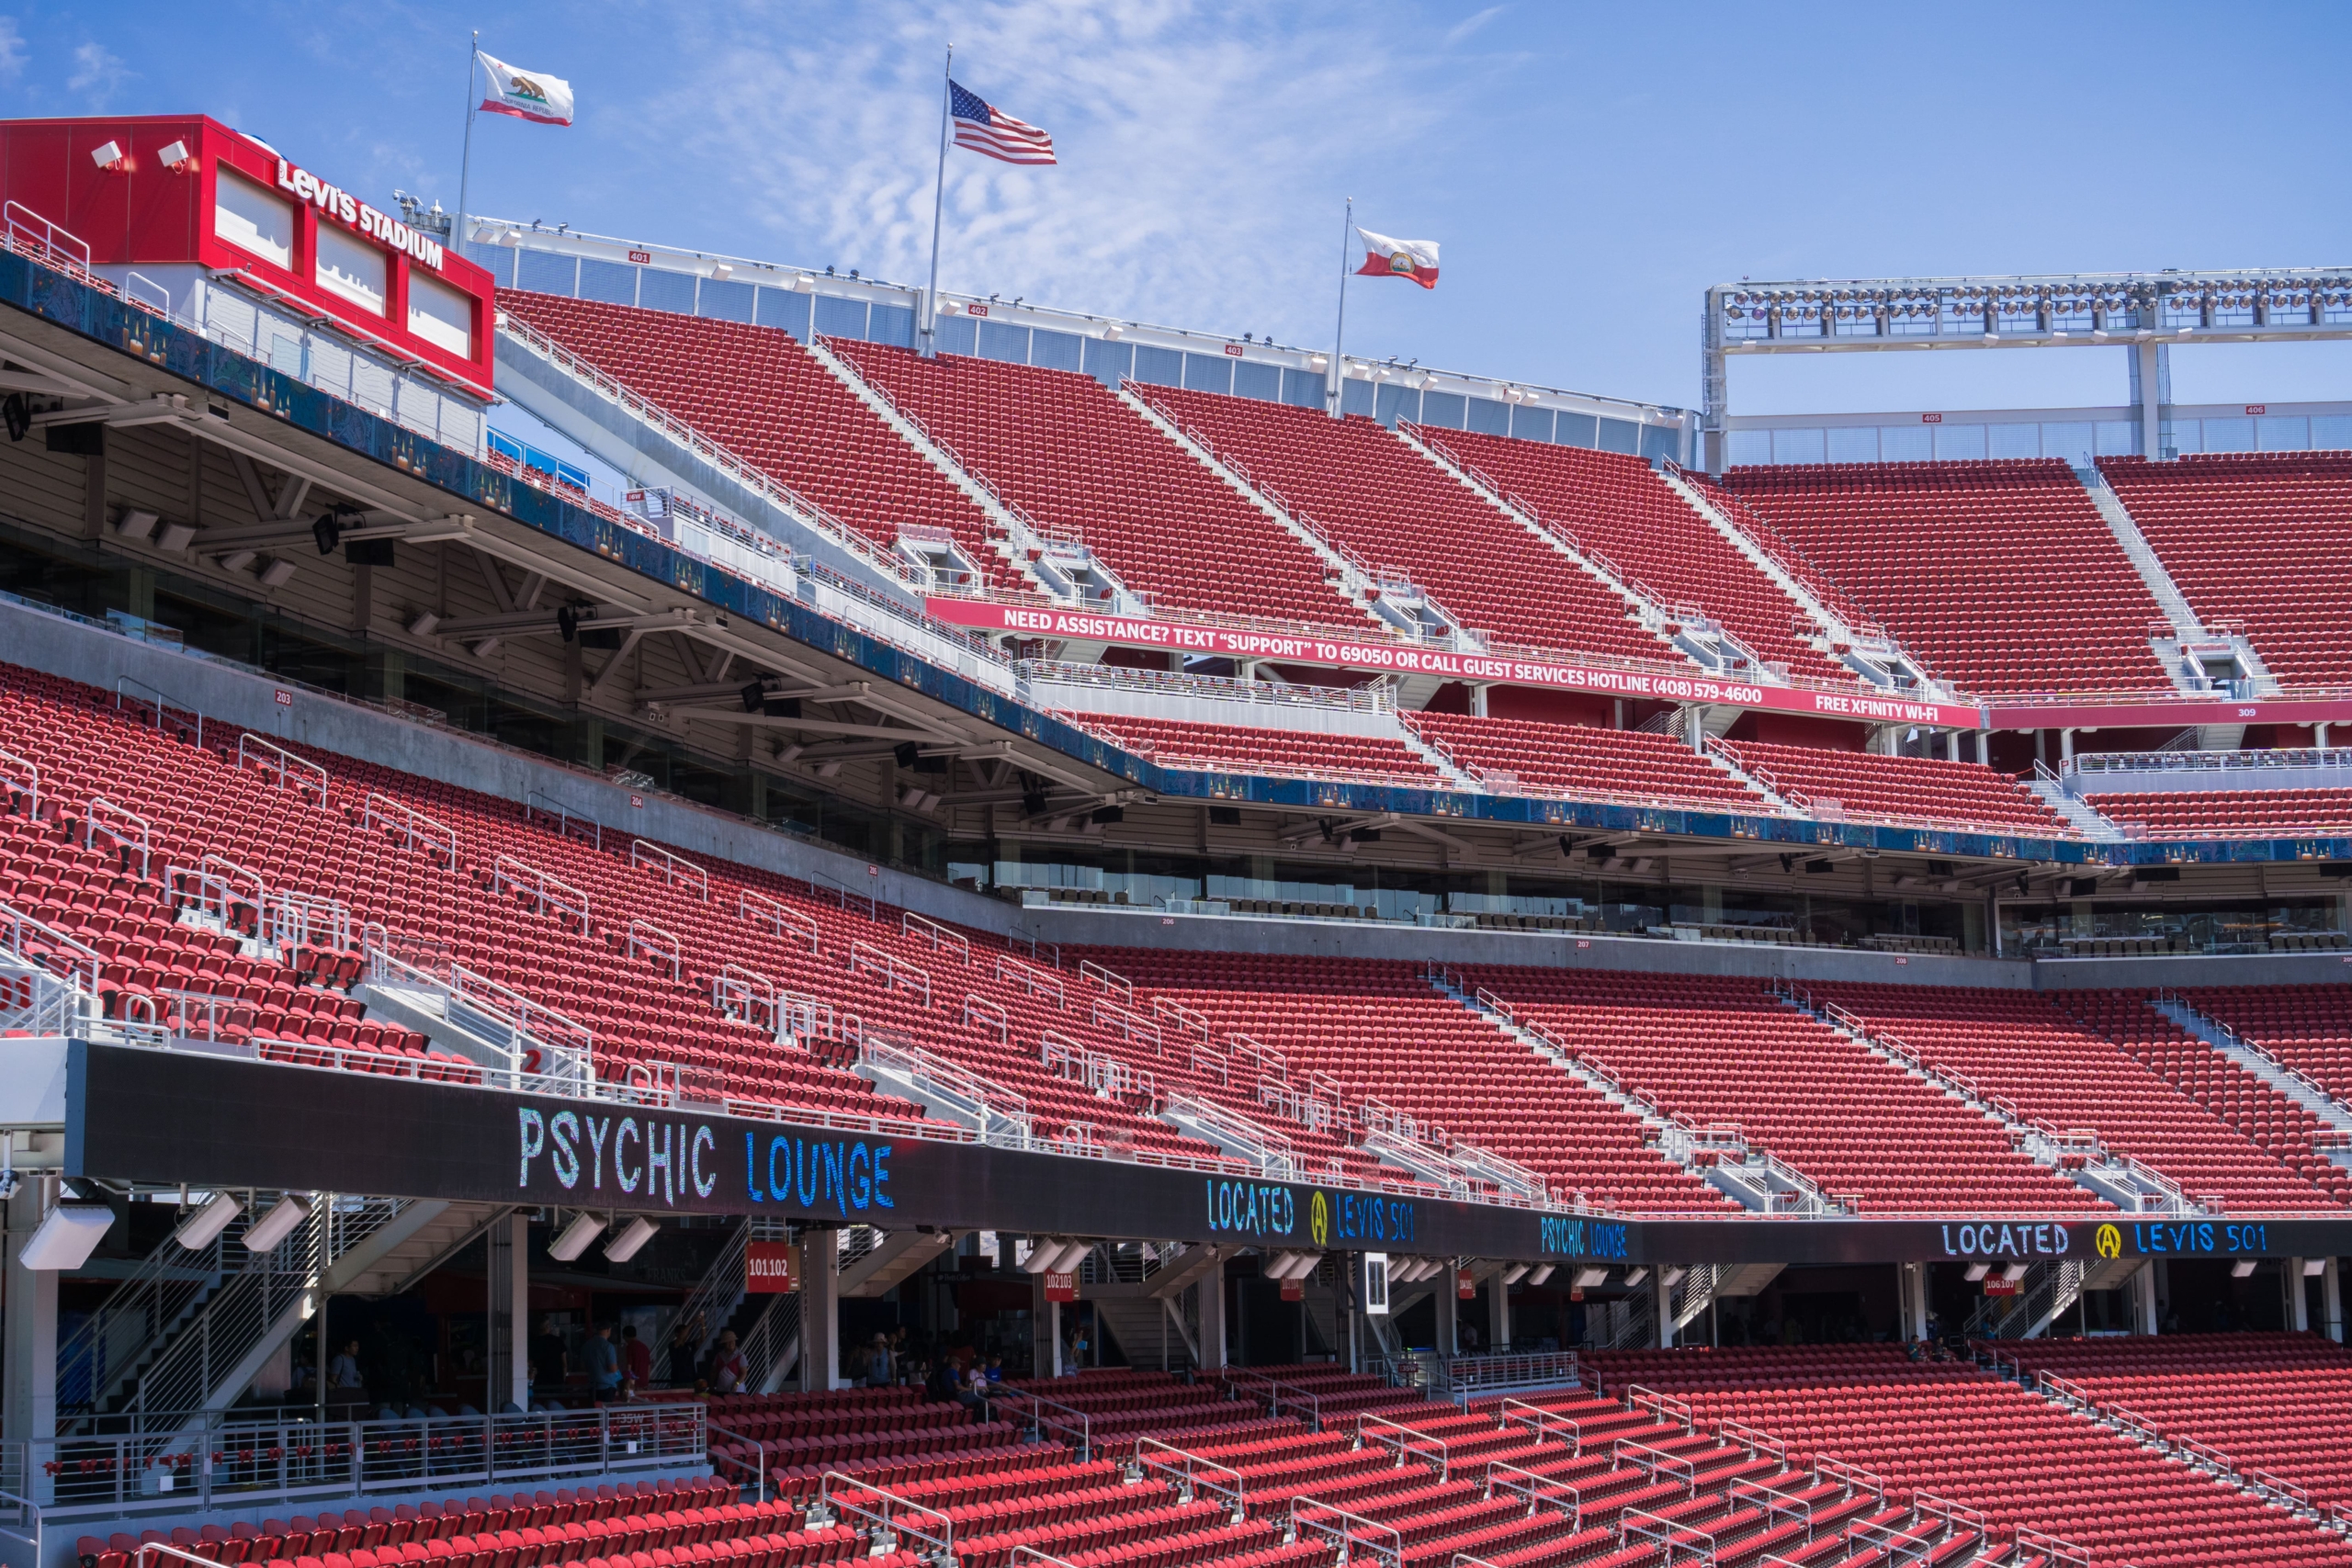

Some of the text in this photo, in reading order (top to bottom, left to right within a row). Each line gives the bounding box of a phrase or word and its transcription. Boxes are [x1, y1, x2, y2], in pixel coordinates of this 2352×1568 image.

[360, 204, 443, 271] STADIUM
[630, 252, 649, 263] 401
[970, 306, 987, 316] 402
[1227, 346, 1241, 355] 403
[1924, 414, 1940, 423] 405
[1435, 625, 1449, 637] 403
[1004, 609, 1052, 630] NEED
[1056, 615, 1168, 643] ASSISTANCE?
[1173, 628, 1216, 649] TEXT
[1315, 643, 1337, 660] TO
[1340, 646, 1392, 667] 69050
[1396, 651, 1419, 669] OR
[1421, 654, 1461, 673] CALL
[1464, 659, 1512, 679] GUEST
[1514, 662, 1585, 685] SERVICES
[1588, 671, 1650, 693] HOTLINE
[1652, 677, 1691, 698] (408)
[1694, 682, 1762, 704] 579-4600
[1733, 658, 1747, 670] 404
[277, 692, 291, 705] 203
[1815, 694, 1939, 721] FREE XFINITY WI-FI
[2238, 708, 2256, 716] 309
[632, 796, 642, 807] 204
[869, 865, 879, 875] 205
[518, 1107, 895, 1218] PSYCHIC LOUNGE
[1780, 1190, 1800, 1203] 207
[1206, 1179, 1295, 1237] LOCATED
[1335, 1193, 1385, 1239] LEVIS
[1390, 1201, 1415, 1242] 501
[1541, 1217, 1627, 1261] PSYCHIC LOUNGE
[1942, 1224, 2069, 1257] LOCATED
[2135, 1224, 2215, 1252] LEVIS
[2225, 1225, 2267, 1251] 501
[749, 1258, 788, 1277] 101 102
[1046, 1274, 1072, 1289] 102 103
[1986, 1280, 2015, 1289] 106 107
